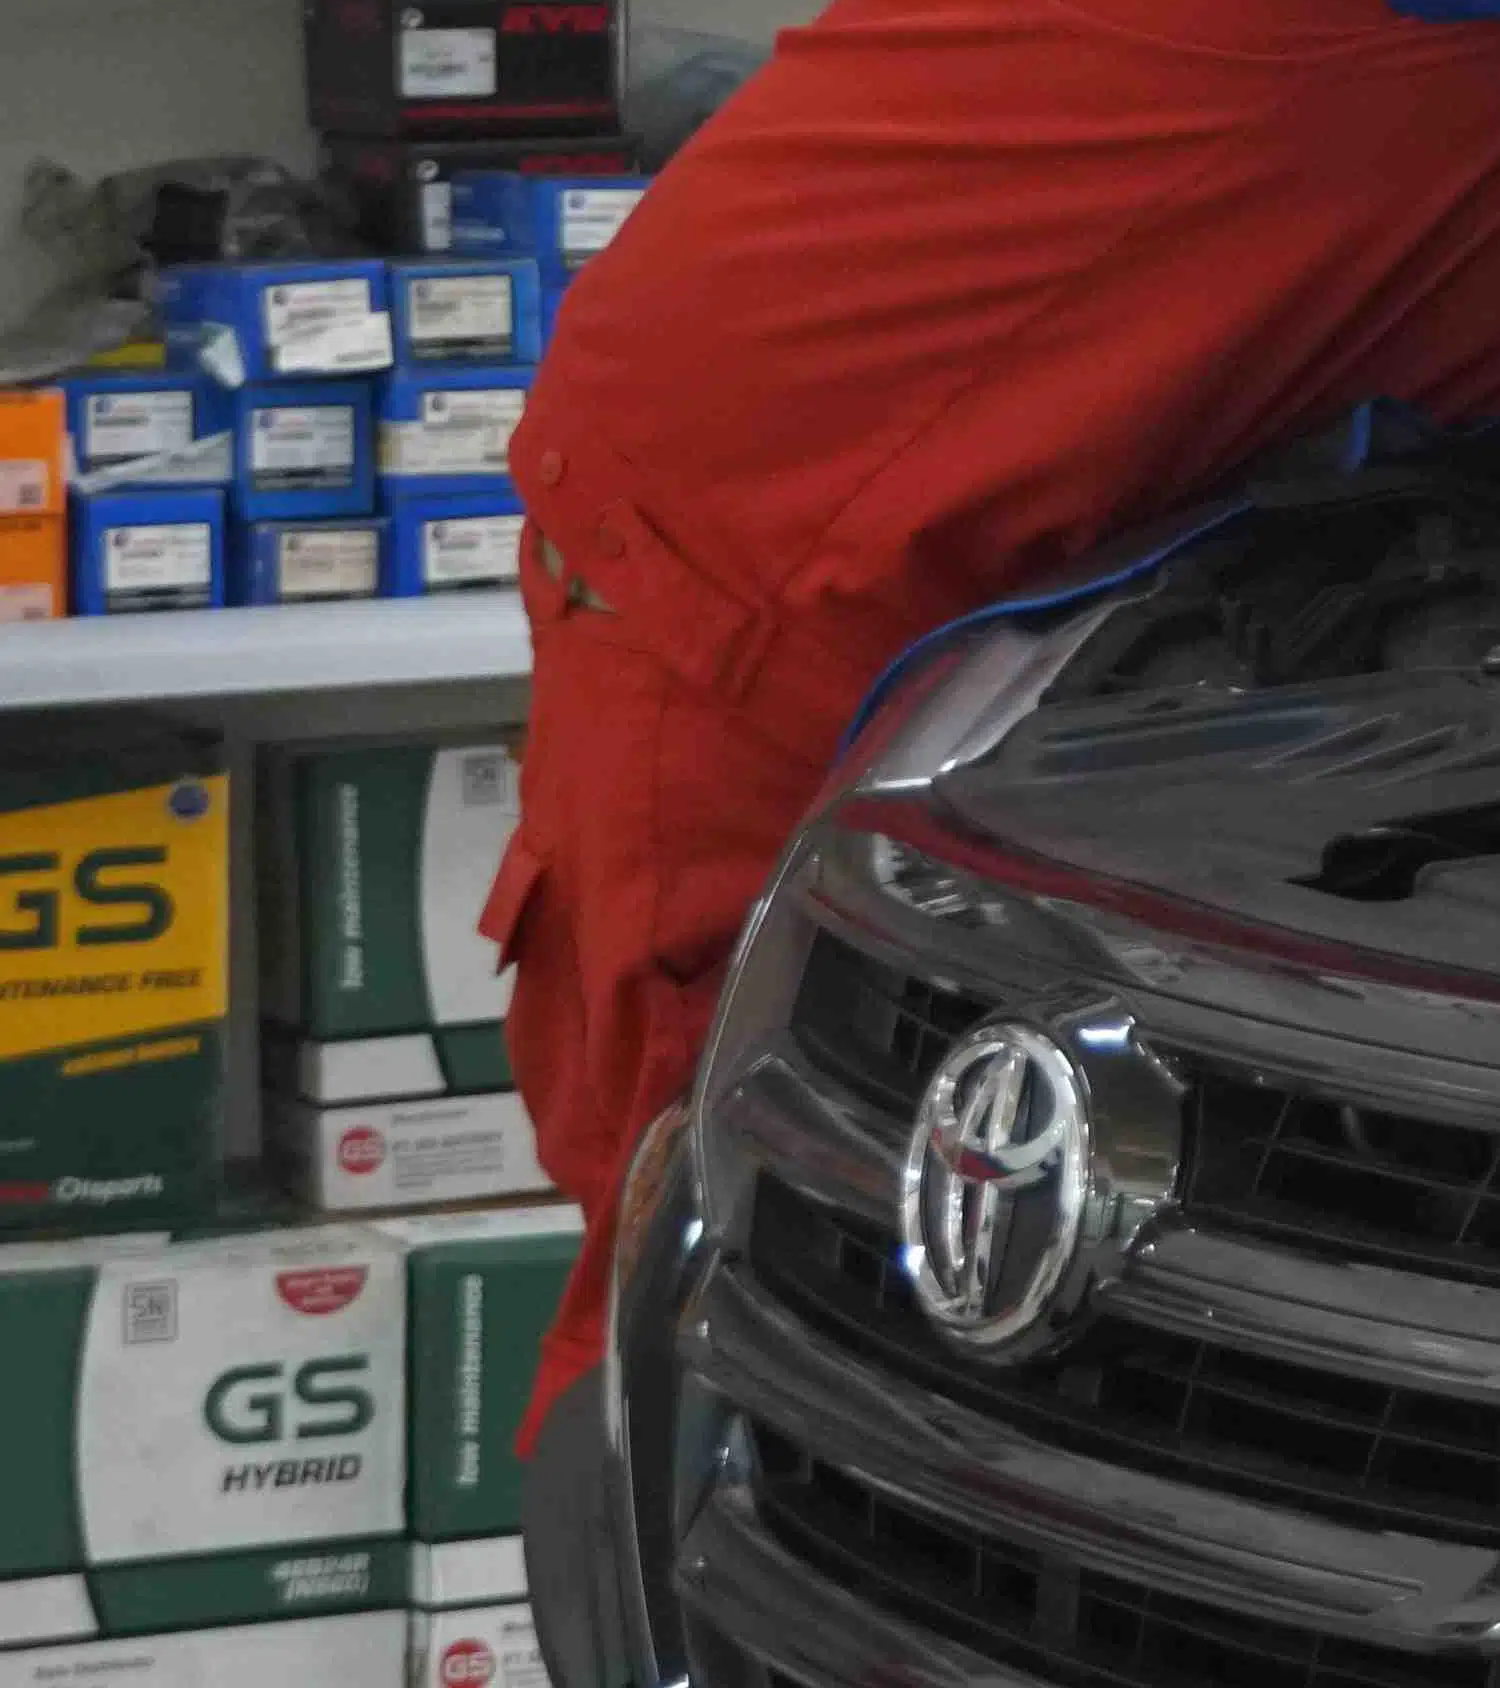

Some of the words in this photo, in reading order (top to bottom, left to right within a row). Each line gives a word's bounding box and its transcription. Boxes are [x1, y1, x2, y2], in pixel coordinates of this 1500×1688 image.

[456, 1274, 484, 1437] maintenance
[204, 1352, 376, 1444] GS
[220, 1453, 363, 1495] HYBRID
[443, 1653, 490, 1679] GS
